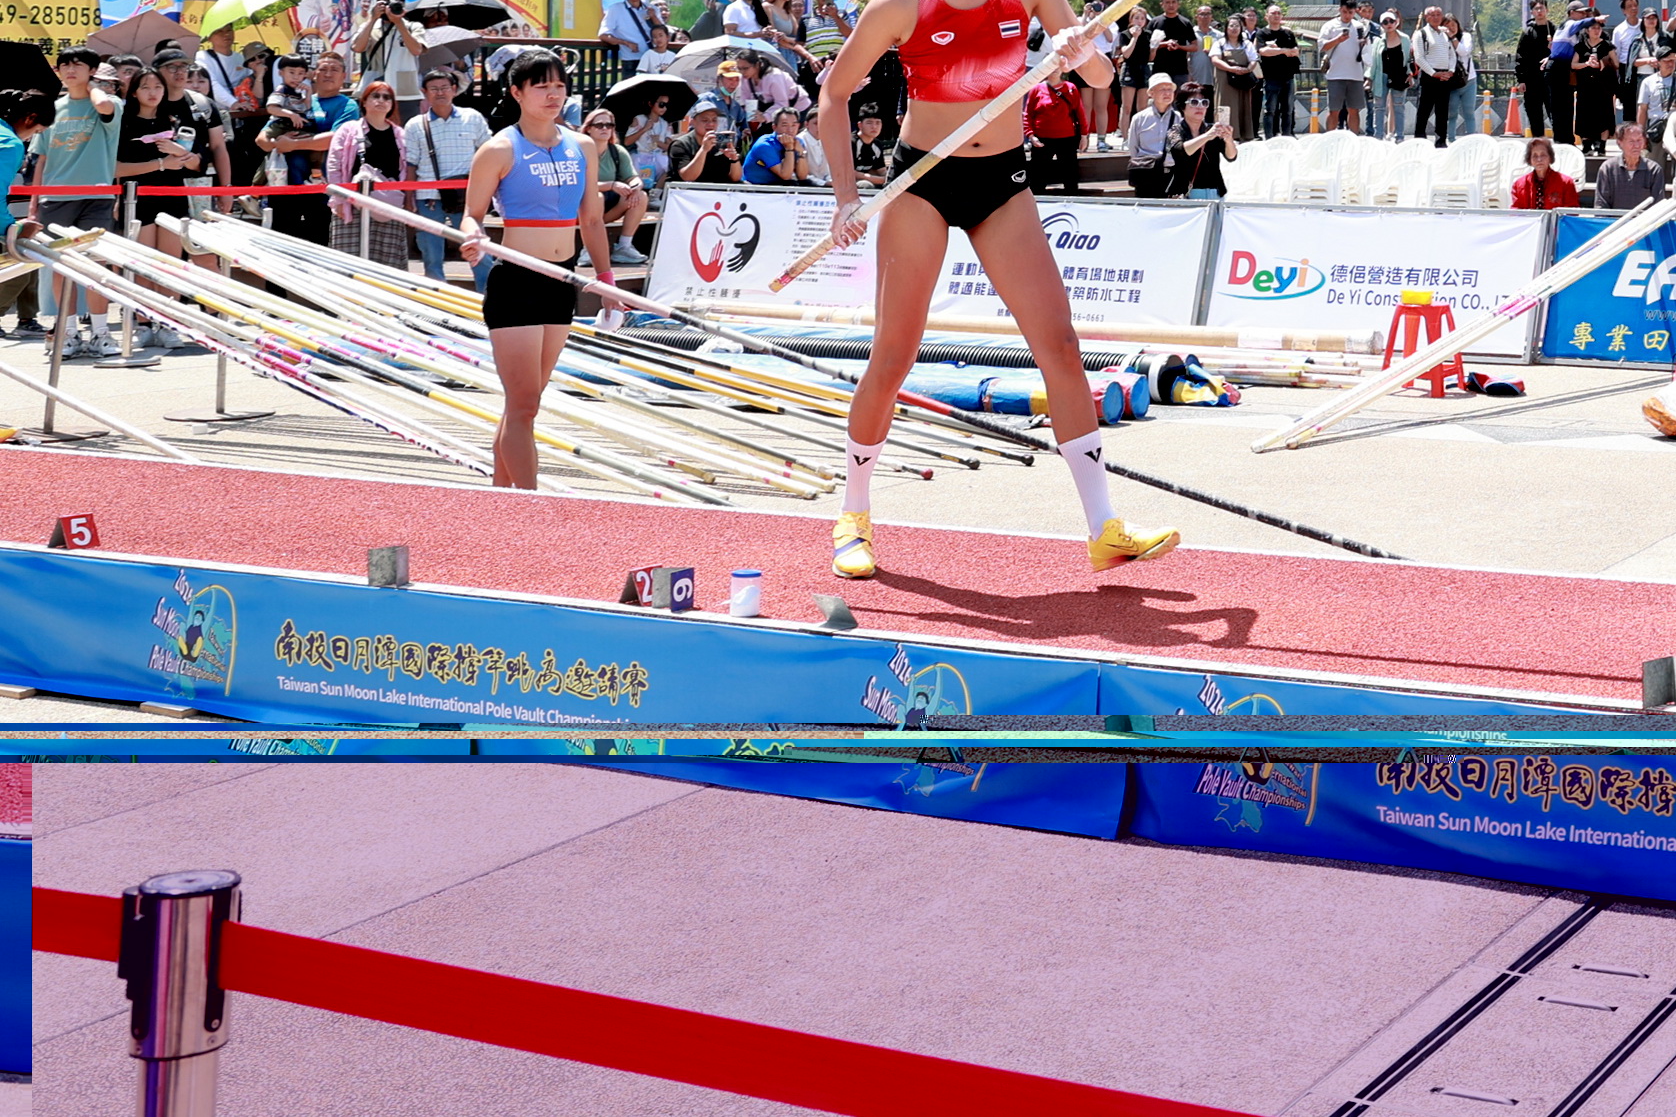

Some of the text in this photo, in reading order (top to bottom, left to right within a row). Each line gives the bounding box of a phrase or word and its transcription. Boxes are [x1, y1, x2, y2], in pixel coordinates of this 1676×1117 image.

[529, 160, 580, 176] CHINESE
[539, 174, 578, 187] TAIPEI
[1055, 230, 1101, 250] Qiao
[1062, 265, 1145, 283] 體育場地規劃
[1227, 250, 1310, 294] Deyi
[1327, 288, 1345, 305] De
[1349, 288, 1362, 305] Yi
[1364, 289, 1457, 309] Consion
[70, 517, 92, 546] 5
[277, 676, 319, 694] Taiwan
[320, 680, 343, 698] Sun
[344, 684, 378, 702] Moon
[379, 687, 406, 705] Lake
[407, 691, 484, 716] International
[485, 701, 512, 719] Pole
[512, 705, 546, 723] Vault
[1218, 767, 1243, 799] Vault
[1242, 780, 1307, 811] Championships
[1272, 769, 1307, 798] ernational
[1376, 806, 1435, 829] Taiwan
[1438, 811, 1471, 832] Sun
[1473, 816, 1523, 838] Moon
[1526, 821, 1566, 842] Lake
